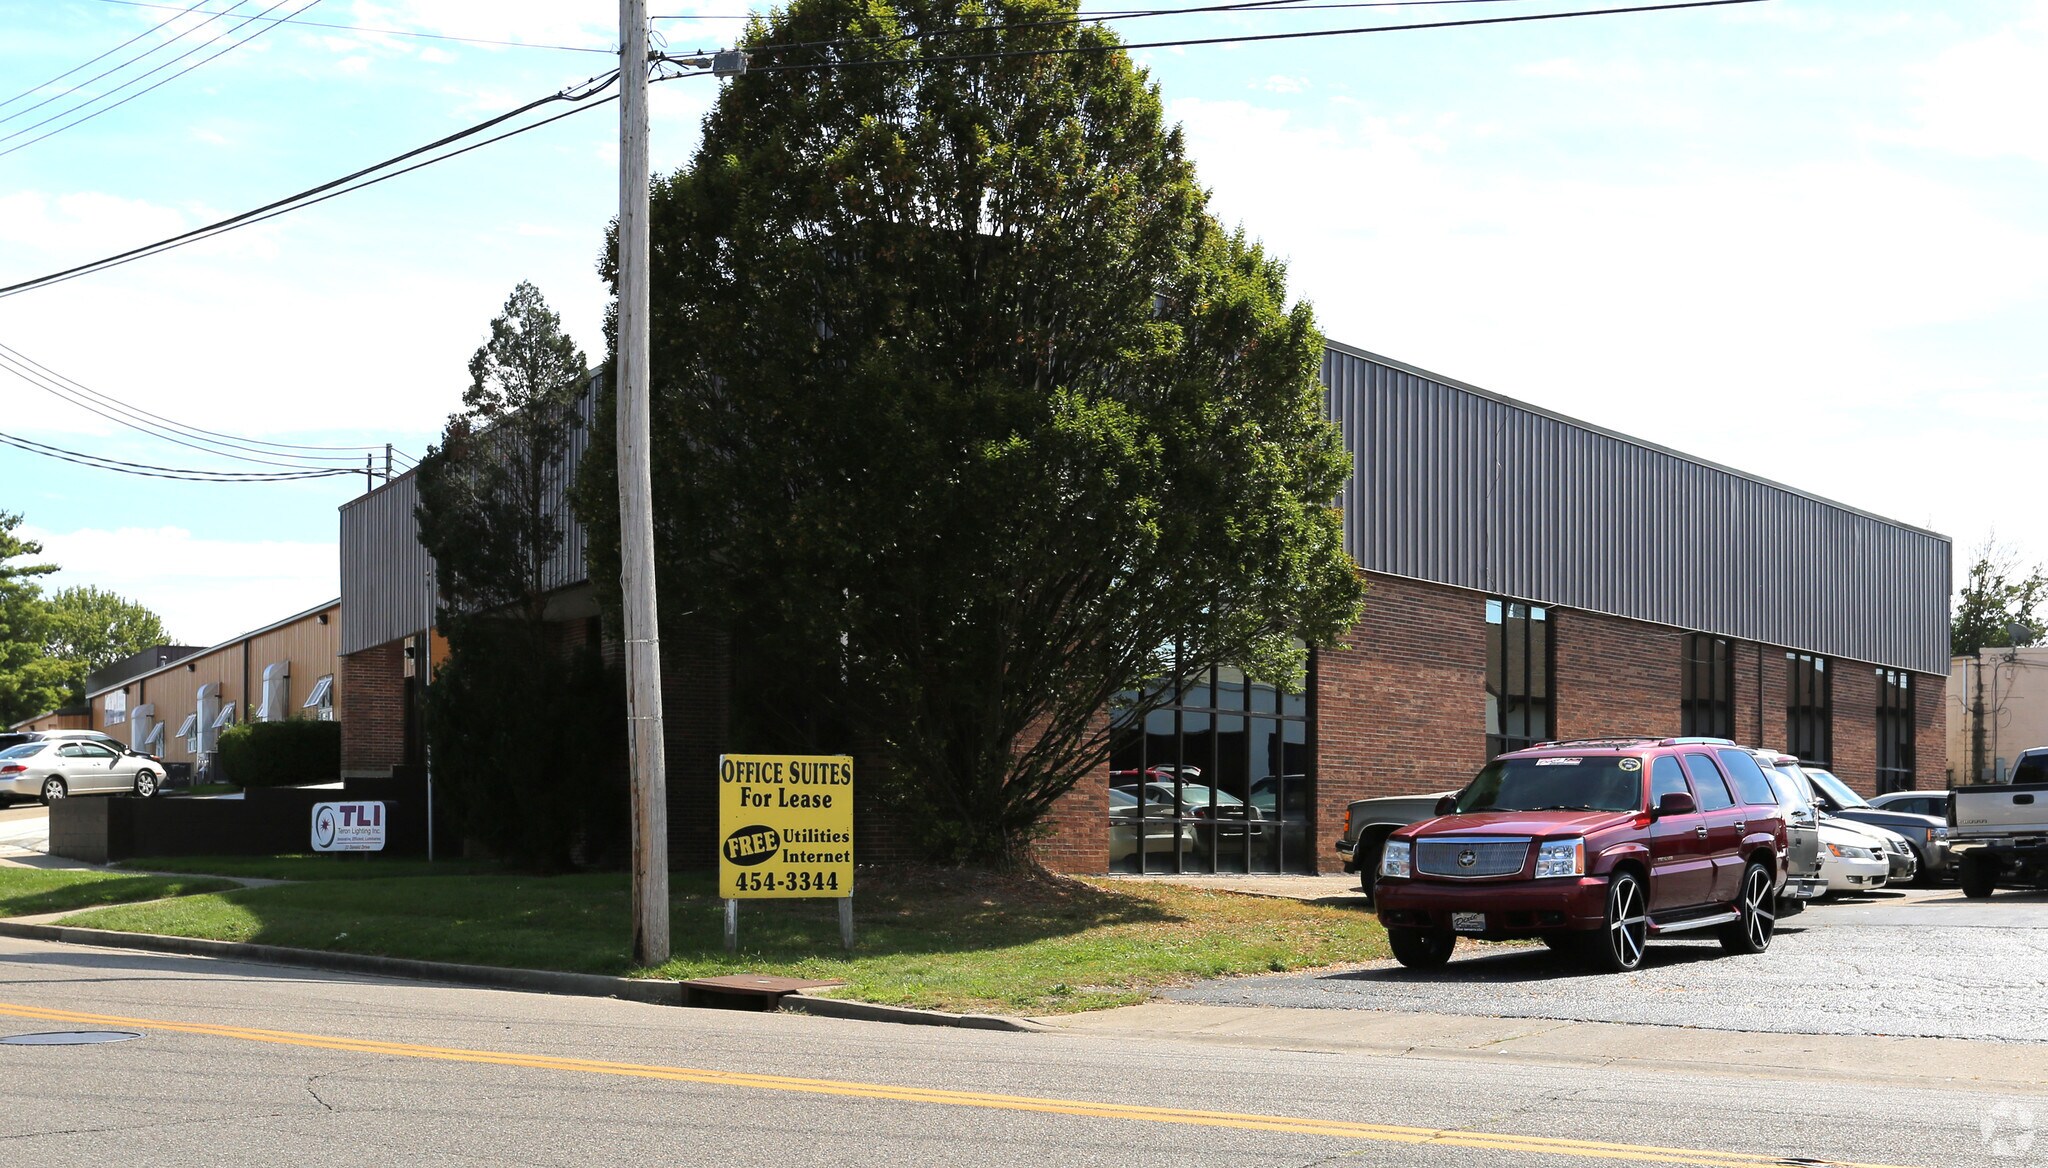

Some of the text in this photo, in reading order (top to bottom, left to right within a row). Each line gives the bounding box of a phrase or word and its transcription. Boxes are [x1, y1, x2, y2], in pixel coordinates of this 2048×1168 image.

[721, 759, 851, 785] OFFICE SUITES
[740, 787, 832, 808] For Lease
[339, 805, 381, 827] TLI
[351, 827, 371, 836] Lighting
[783, 829, 850, 843] Utilities
[727, 831, 778, 858] FREE
[783, 849, 850, 863] Internet
[735, 872, 838, 891] 454-3344
